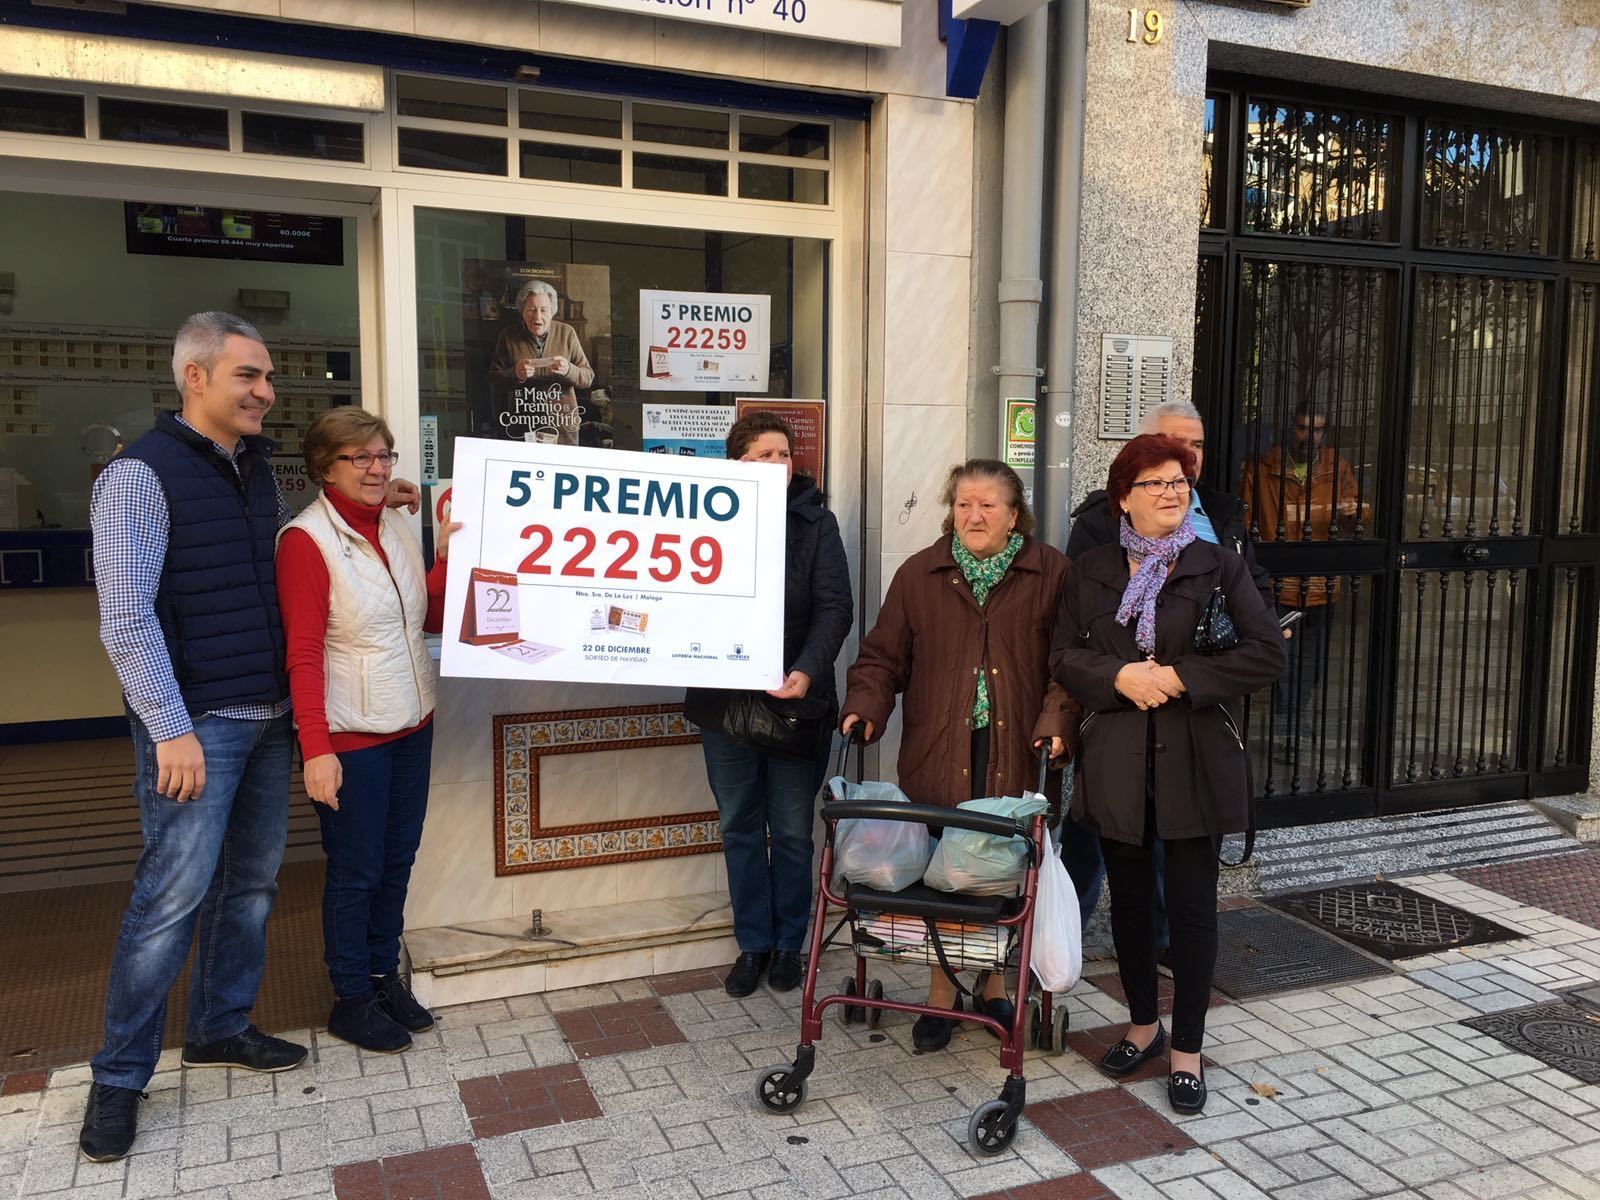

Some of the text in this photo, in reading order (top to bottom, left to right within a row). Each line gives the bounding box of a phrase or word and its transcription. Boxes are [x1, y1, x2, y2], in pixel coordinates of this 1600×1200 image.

[773, 0, 806, 23] 40
[1126, 7, 1163, 44] 19
[280, 229, 311, 237] 60.000€
[679, 304, 753, 323] PREMIO
[667, 326, 747, 350] 22259
[524, 383, 562, 403] Mayor
[515, 398, 562, 415] Premio
[500, 406, 586, 431] Compartirlo
[270, 464, 308, 475] EMIO
[553, 472, 740, 522] PREMIO
[516, 524, 723, 585] 22259
[486, 587, 512, 613] 22
[582, 644, 651, 654] 22 DE DICIEMBRE
